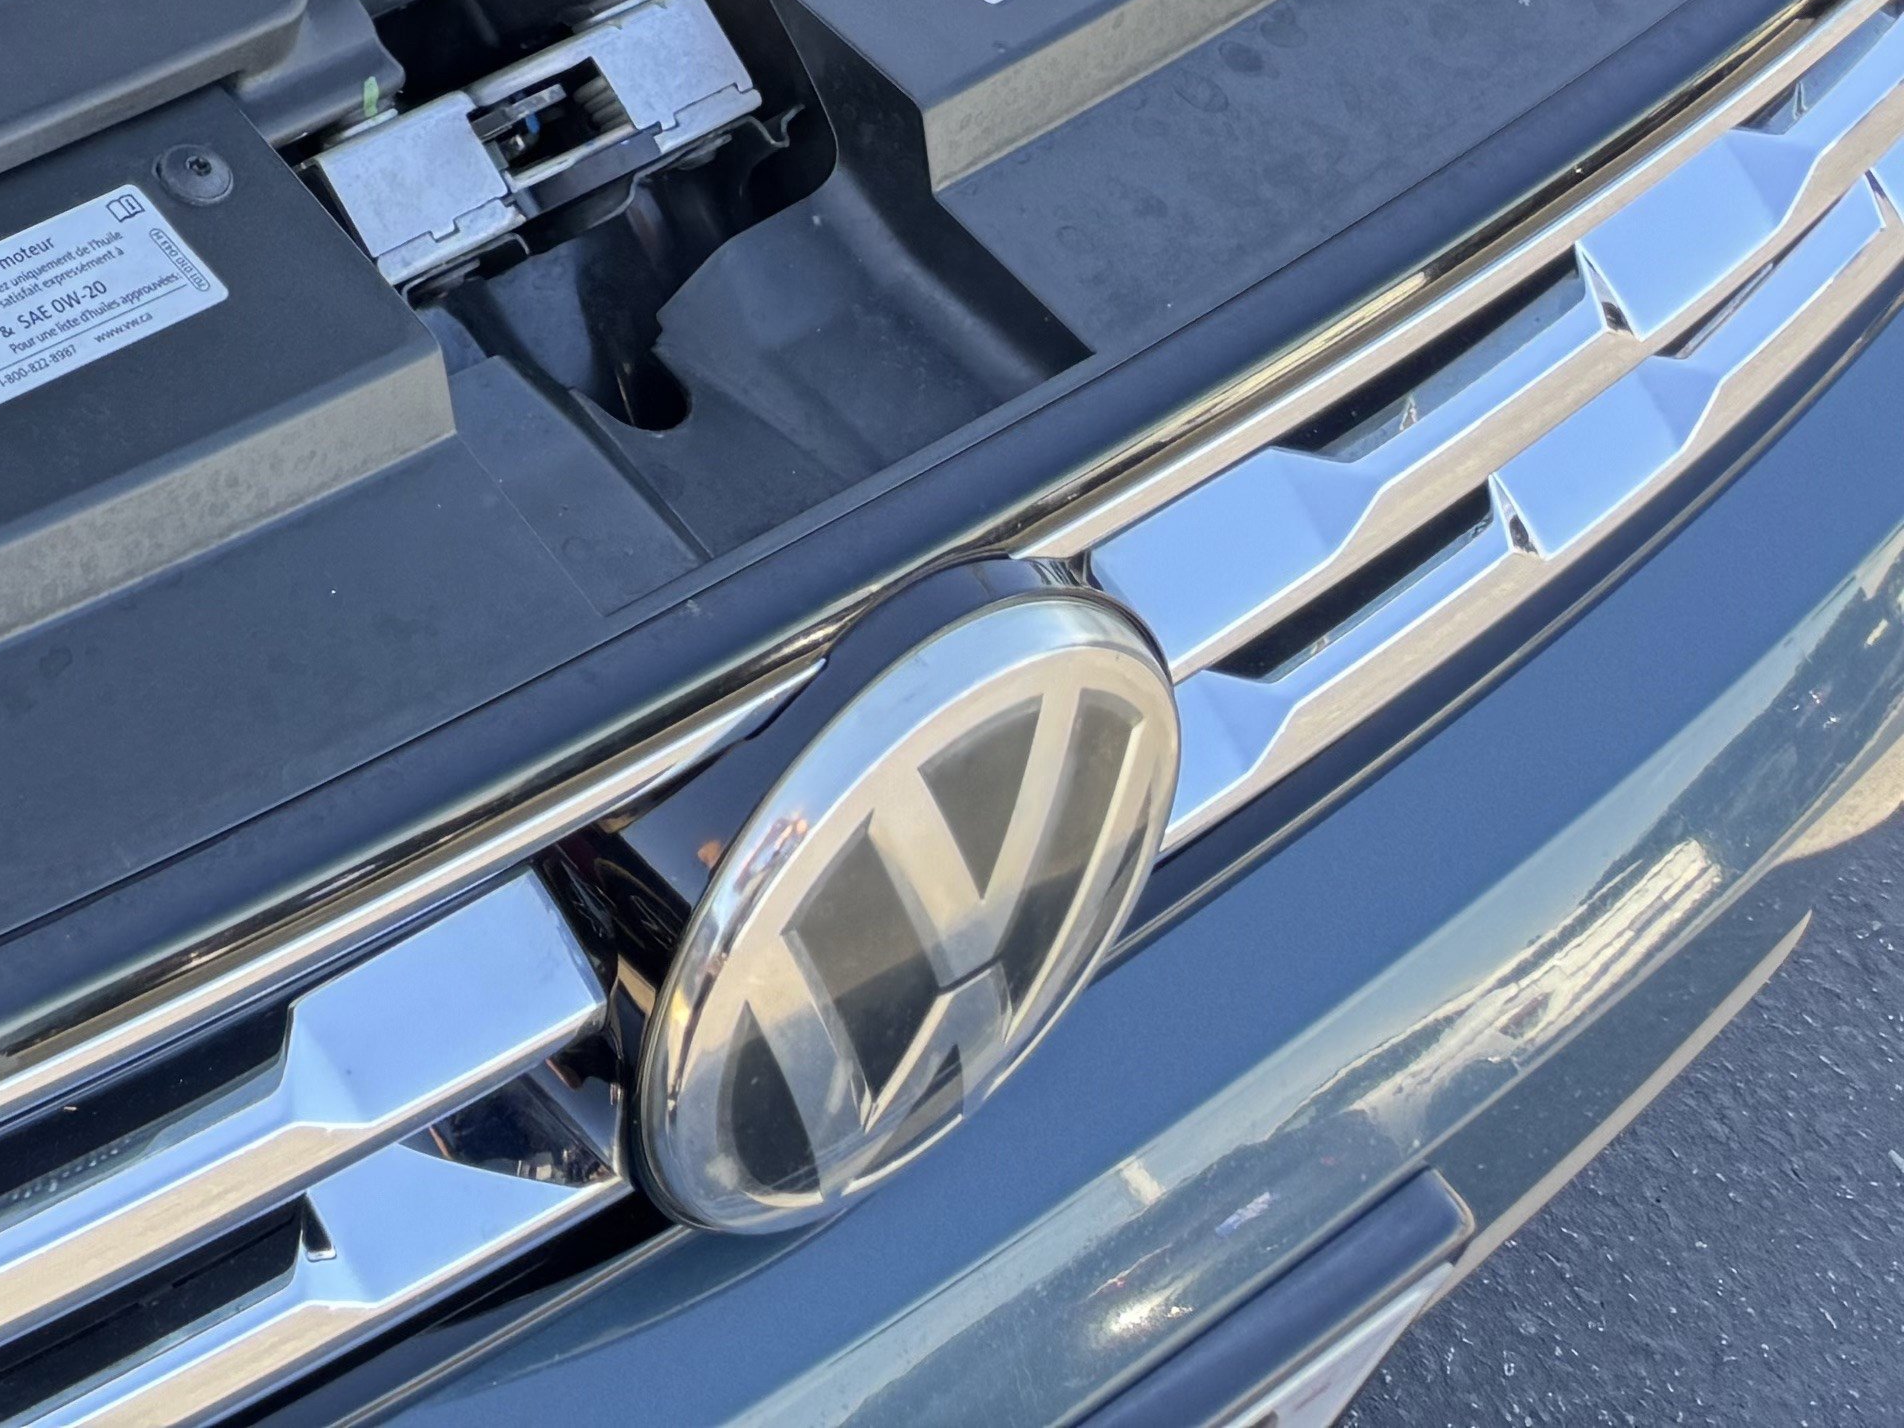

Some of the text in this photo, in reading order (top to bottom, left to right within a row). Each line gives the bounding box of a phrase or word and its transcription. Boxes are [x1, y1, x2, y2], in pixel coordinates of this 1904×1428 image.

[9, 251, 76, 290] uniquement
[74, 245, 91, 257] de
[87, 231, 124, 251] l'huile
[41, 250, 116, 288] expressément
[114, 246, 125, 256] à
[8, 337, 36, 354] Pour
[35, 327, 58, 343] une
[54, 317, 81, 333] liste
[79, 299, 121, 323] d'huiles
[16, 304, 53, 329] SAE
[50, 280, 107, 313] 0W-20
[93, 312, 153, 343] www.vw.ca
[657, 614, 1175, 1226] VW
